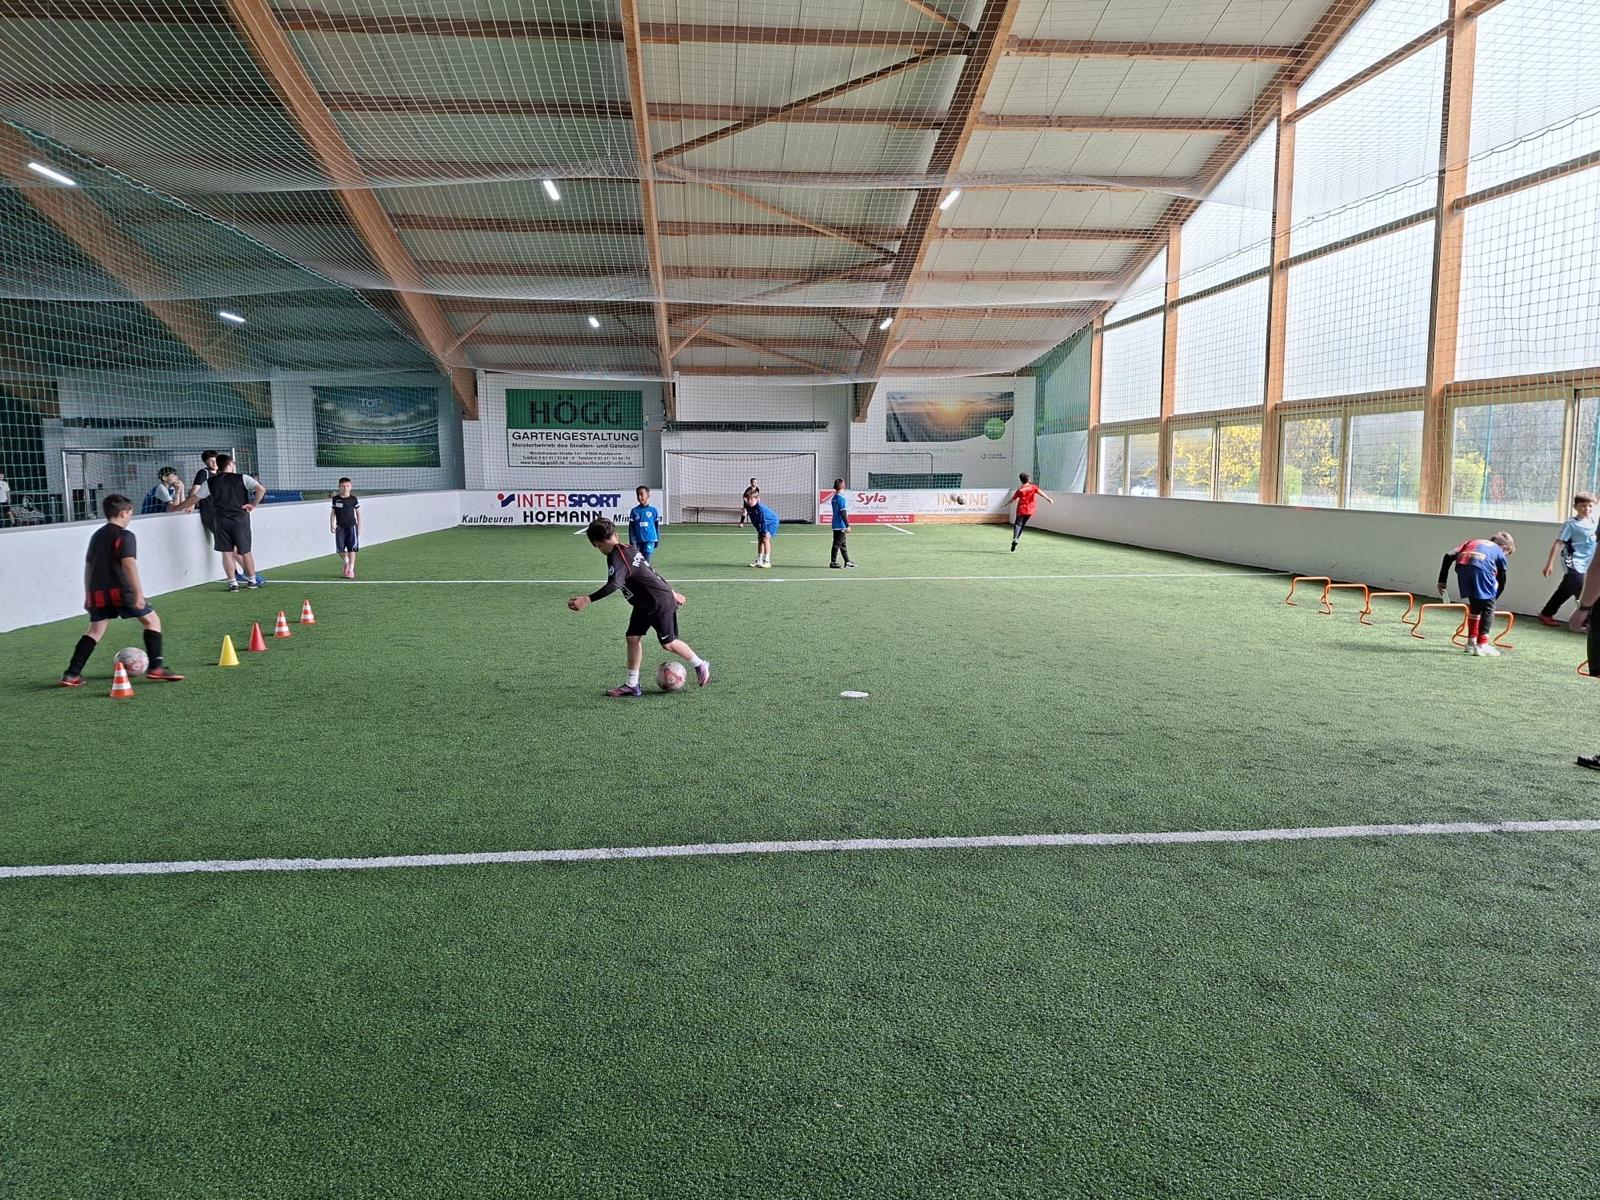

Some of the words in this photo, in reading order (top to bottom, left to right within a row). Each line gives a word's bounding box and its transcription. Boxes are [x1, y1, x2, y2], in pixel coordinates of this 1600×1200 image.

[529, 393, 622, 425] HÖGG
[511, 431, 639, 441] GARTENGESTALTUNG
[516, 493, 621, 508] INTERSPORT
[856, 492, 887, 505] Syla
[461, 514, 514, 524] Kaufbeuren
[523, 510, 603, 523] HOFMANN
